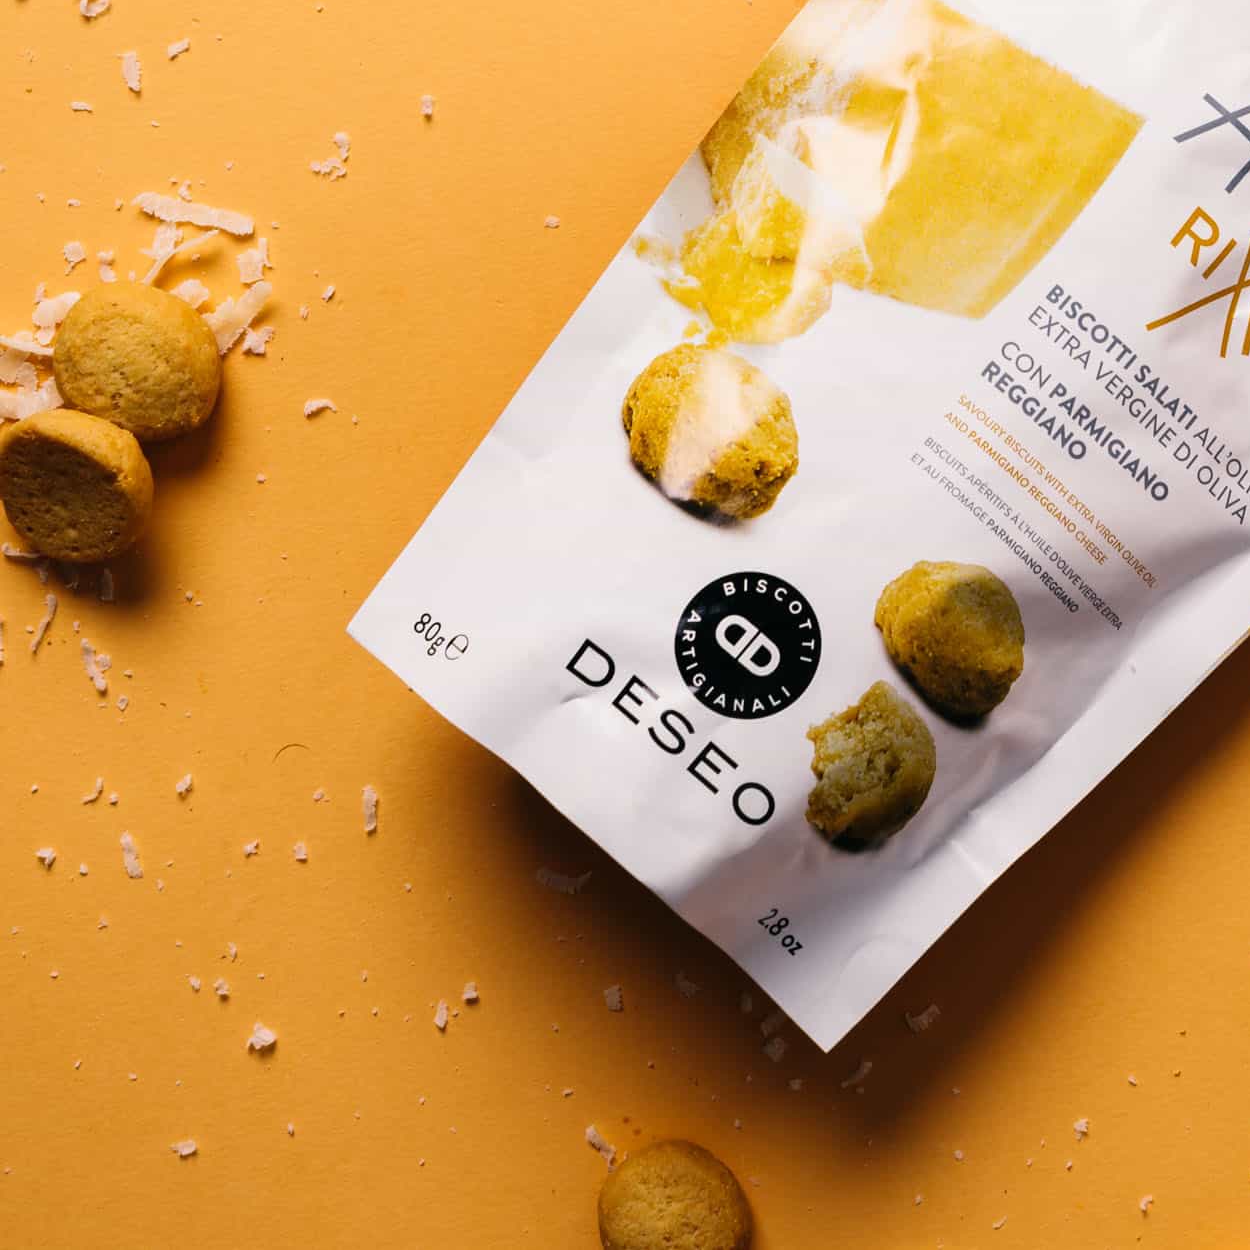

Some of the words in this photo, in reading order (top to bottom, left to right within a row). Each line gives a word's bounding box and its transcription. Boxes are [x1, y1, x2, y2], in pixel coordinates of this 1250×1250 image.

[981, 361, 1087, 460] REGGIANO
[1001, 342, 1052, 390] CON
[1048, 382, 1169, 501] PARMIGIANO
[1028, 305, 1091, 370] EXTRA
[1096, 360, 1180, 448] VERGINE
[1172, 440, 1199, 470] DI
[1197, 466, 1248, 525] OLIVA
[1046, 284, 1138, 370] BISCOTTI
[1131, 364, 1198, 430] SALATI
[910, 452, 926, 468] ET
[922, 462, 940, 480] AU
[936, 474, 991, 526] FROMAGE
[984, 518, 1045, 575] PARMIGIANO
[1038, 570, 1084, 613] REGGIANO
[924, 436, 971, 481] BISCUITS
[1078, 580, 1108, 614] VIERGE
[1101, 606, 1123, 630] EXTRA
[944, 412, 969, 436] AND
[964, 430, 1033, 492] PARMIGIANO
[1025, 484, 1079, 534] REGGIANO
[1072, 530, 1110, 566] CHEESE
[957, 393, 1008, 442] SAVOURY
[1002, 434, 1048, 478] BISCUITS
[1040, 471, 1069, 499] WITH
[1063, 493, 1097, 526] EXTRA
[1094, 520, 1125, 554] VIRGIN
[1120, 549, 1148, 577] OLIVE
[682, 610, 791, 713] ARTIGIANALI
[723, 579, 815, 662] BISCOTTI
[566, 638, 775, 825] DESEO
[758, 908, 789, 936] 2.8
[781, 934, 803, 956] oz
